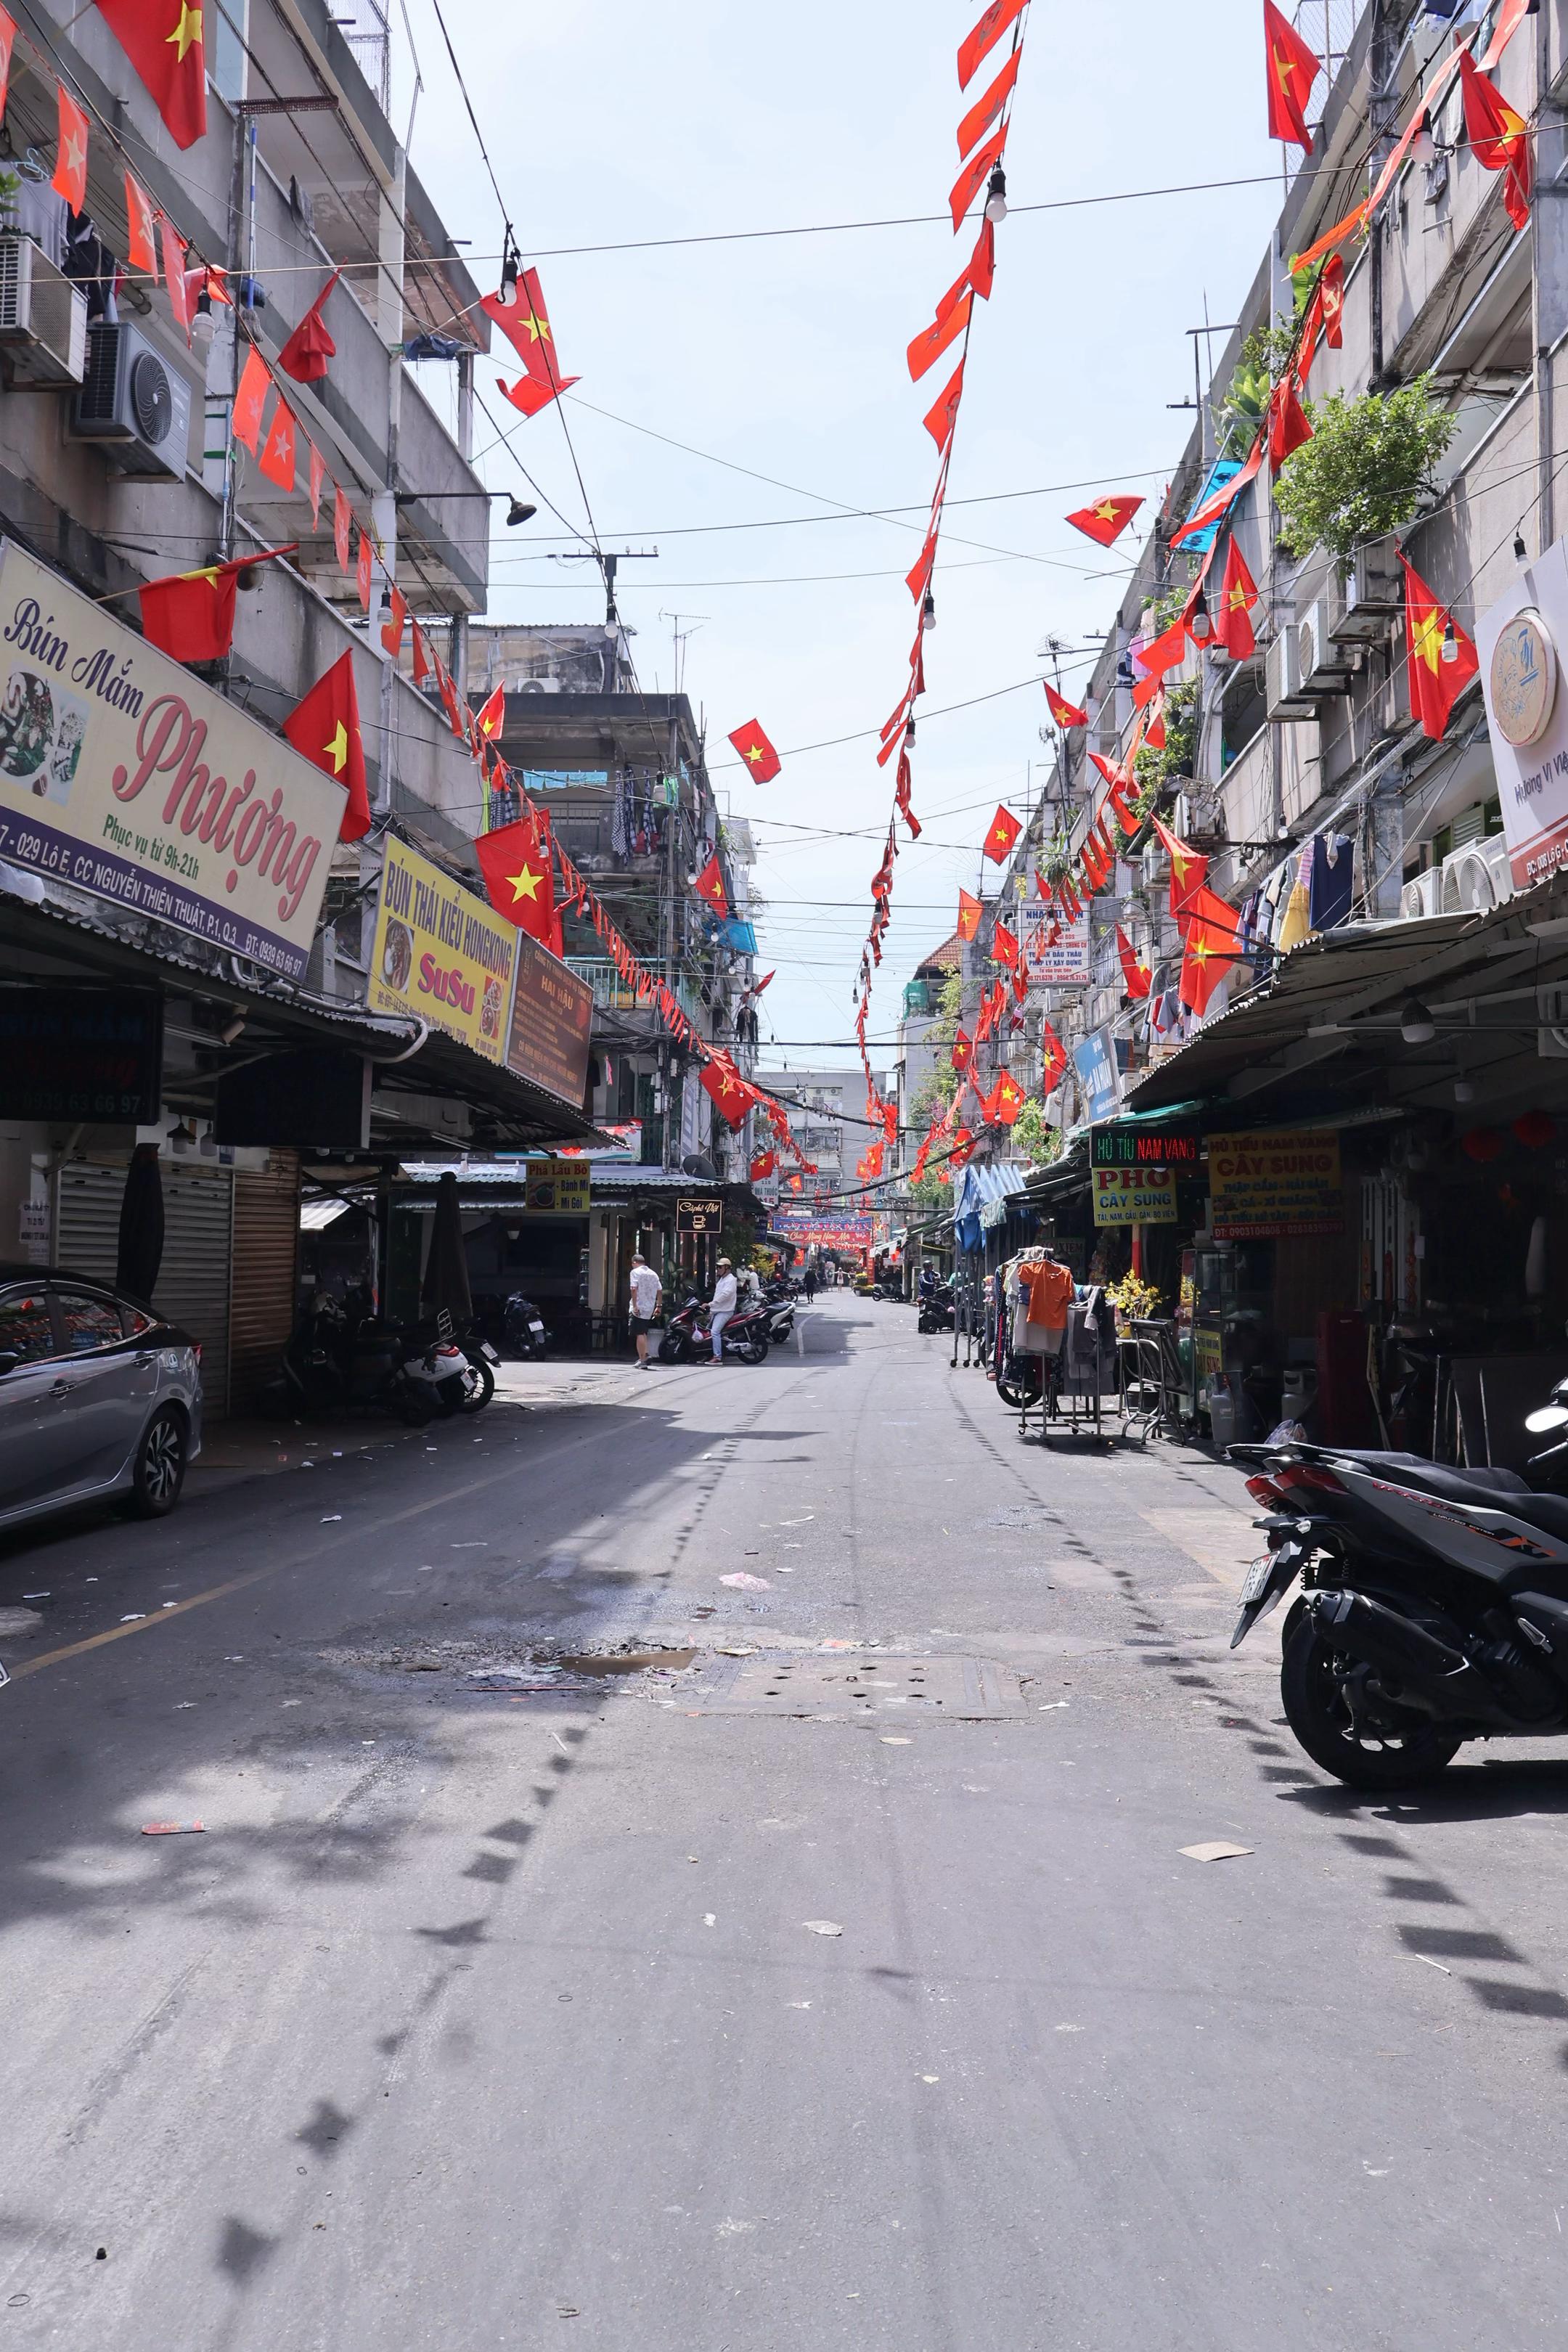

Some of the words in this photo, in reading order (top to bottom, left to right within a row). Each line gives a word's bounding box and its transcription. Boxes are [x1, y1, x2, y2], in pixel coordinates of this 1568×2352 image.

[4, 598, 68, 671] Bún
[71, 649, 144, 719] Mắm
[112, 695, 321, 921] Phượng
[102, 814, 133, 850] Phục
[135, 835, 148, 859] vụ
[150, 837, 166, 862] từ
[166, 844, 200, 881] 9h-21h
[17, 833, 41, 861] 029
[60, 849, 70, 878] E,
[74, 856, 93, 881] CC
[93, 864, 142, 901] NGUYỄN
[223, 923, 237, 944] Q.3
[245, 934, 258, 955] ĐT:
[259, 940, 276, 964] 0939
[276, 950, 285, 968] 63
[285, 954, 293, 973] 66
[293, 959, 302, 976] 97
[384, 858, 413, 919] BÚN
[413, 881, 439, 936] THÁI
[438, 889, 465, 951] KIỂU
[462, 915, 513, 981] HONGKONG
[417, 952, 475, 1016] SuSu
[541, 975, 555, 997] HAI
[557, 987, 573, 1010] HẬU
[528, 1164, 548, 1175] Phá
[552, 1162, 571, 1175] Lấu
[573, 1164, 587, 1175] Bò
[1098, 1132, 1113, 1161] HỦ
[1138, 1138, 1162, 1161] NAM
[1164, 1138, 1196, 1161] VANG
[1217, 1153, 1265, 1177] CÂY
[1271, 1154, 1332, 1174] SUNG
[1100, 1193, 1128, 1208] CÂY
[1134, 1193, 1172, 1206] SUNG
